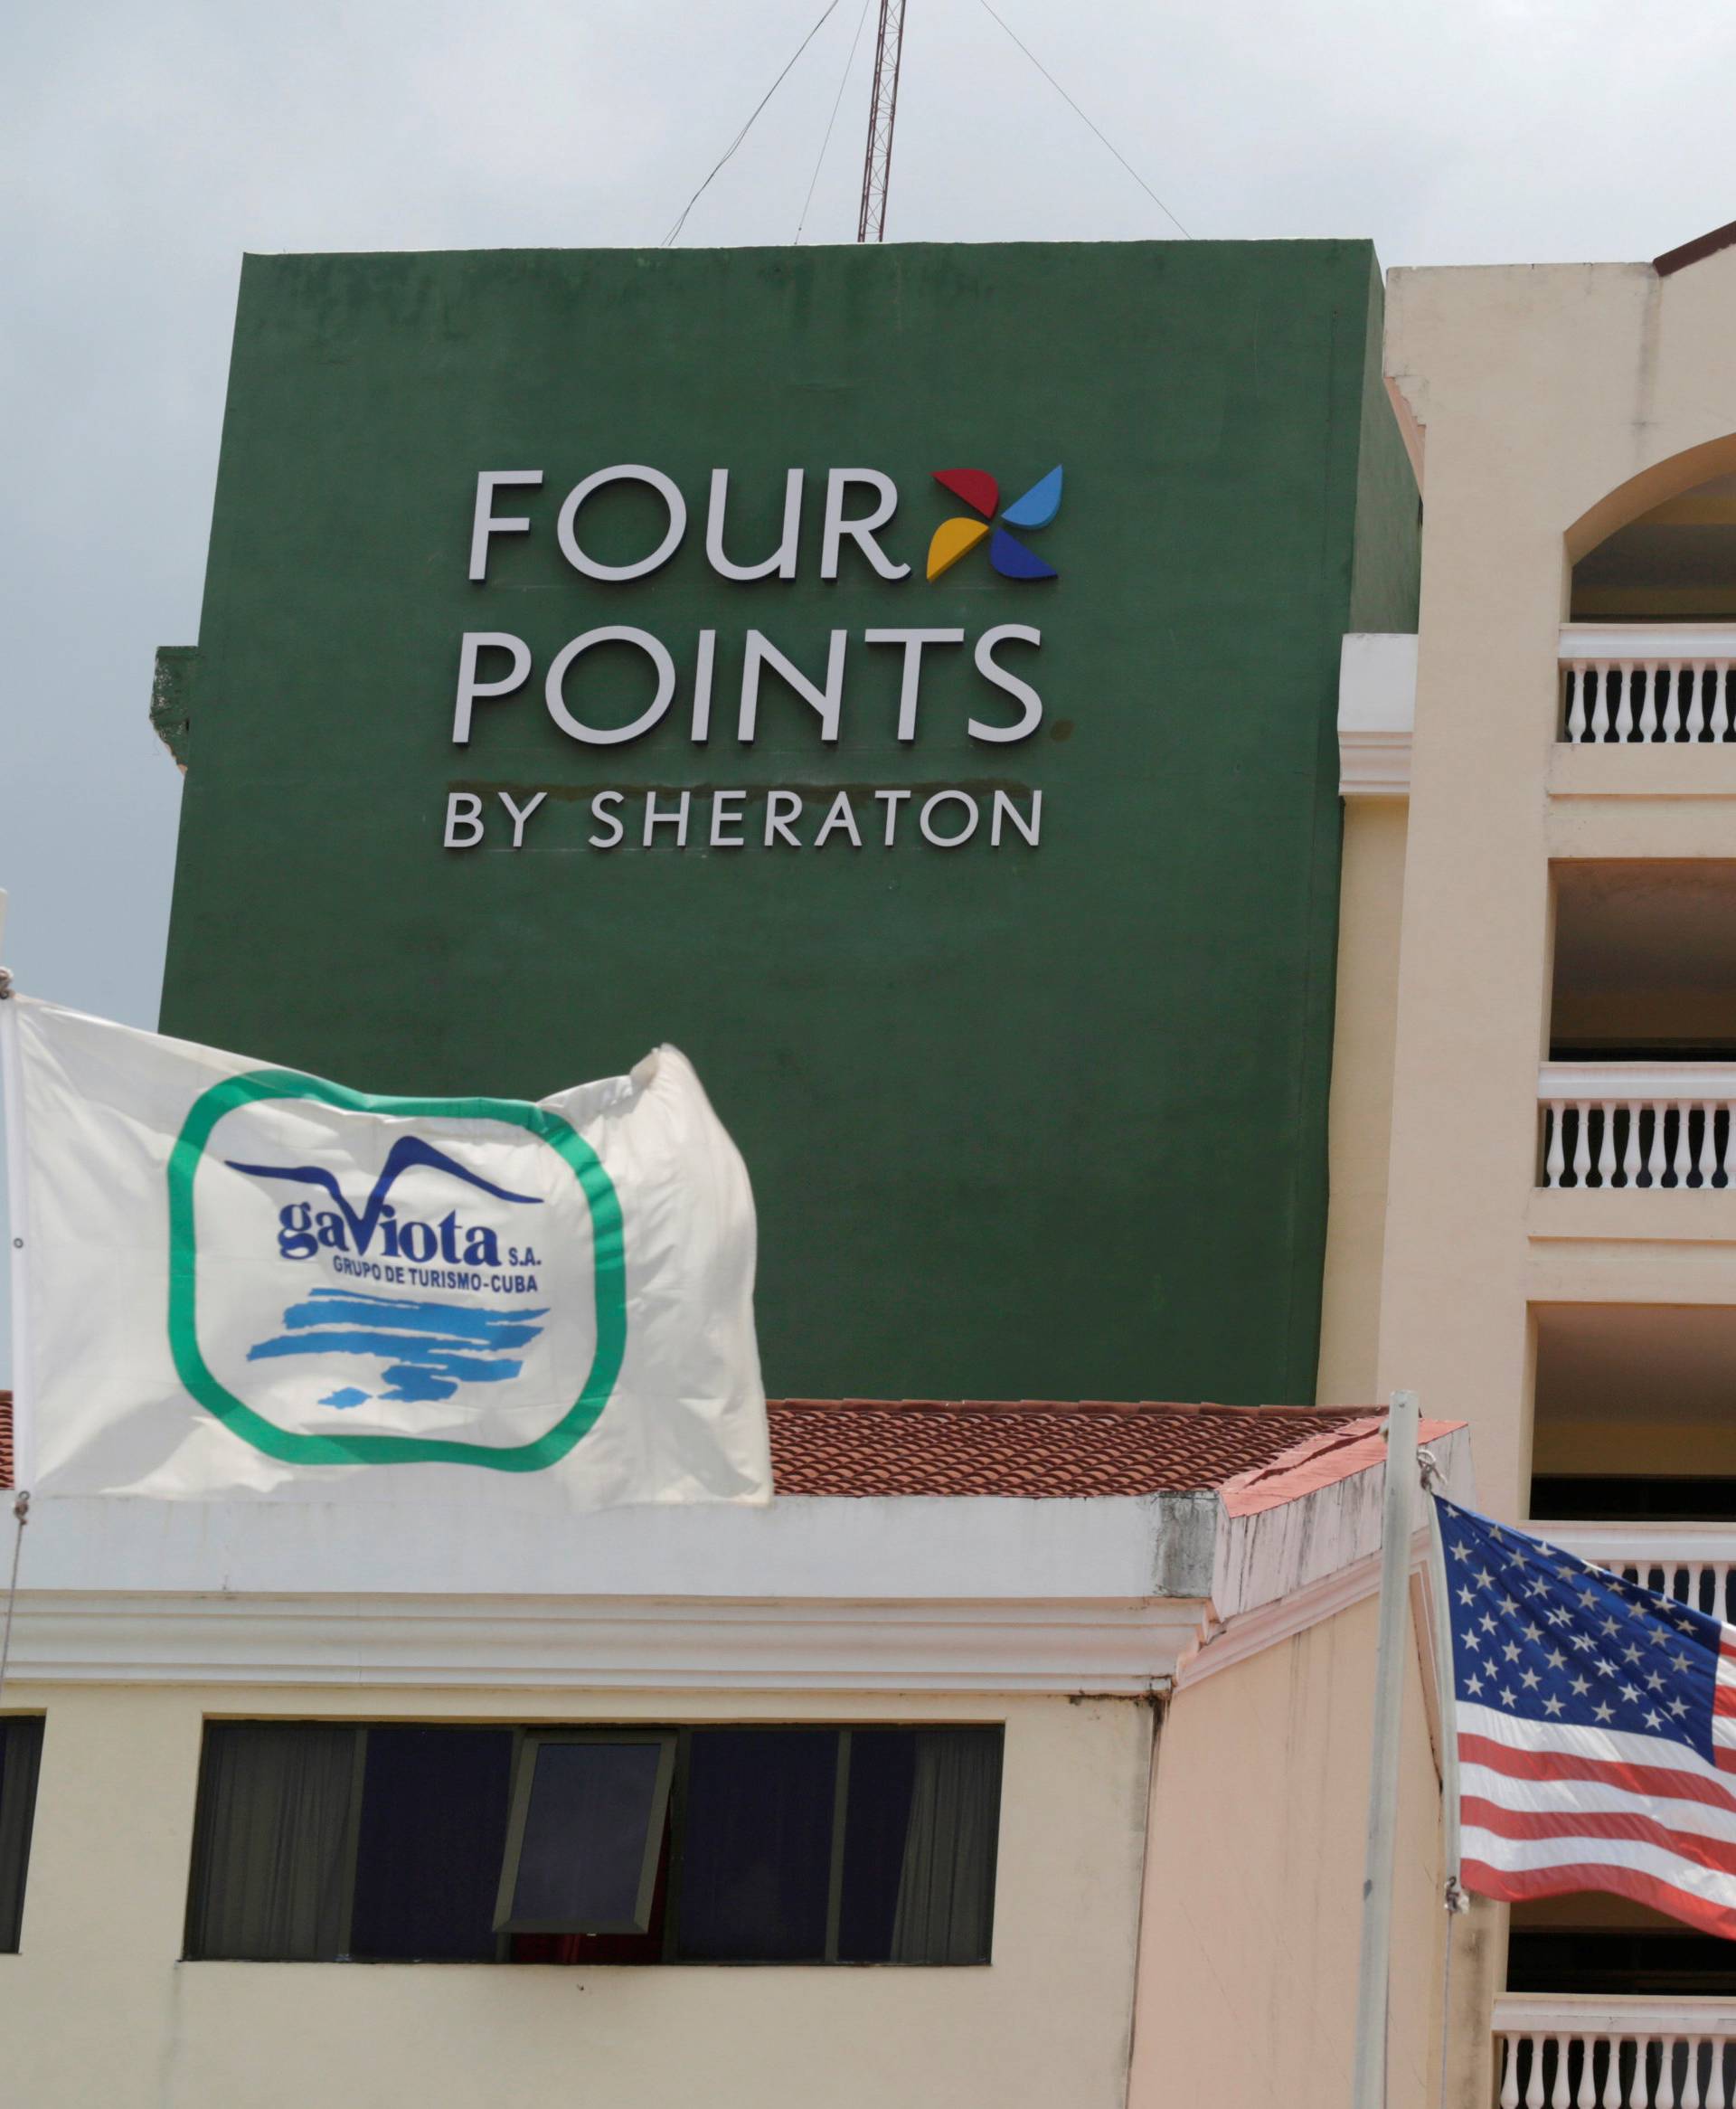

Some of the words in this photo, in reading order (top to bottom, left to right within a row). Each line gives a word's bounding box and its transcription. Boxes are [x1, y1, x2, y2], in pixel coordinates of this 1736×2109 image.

[468, 464, 911, 582] FOUR
[451, 624, 1044, 745] POINTS
[443, 790, 548, 849] BY
[588, 789, 1043, 848] SHERATON
[333, 1254, 382, 1281] GRUPO
[384, 1265, 406, 1284] DE
[409, 1268, 538, 1293] TURISMO-CUBA
[507, 1246, 542, 1267] S.A.
